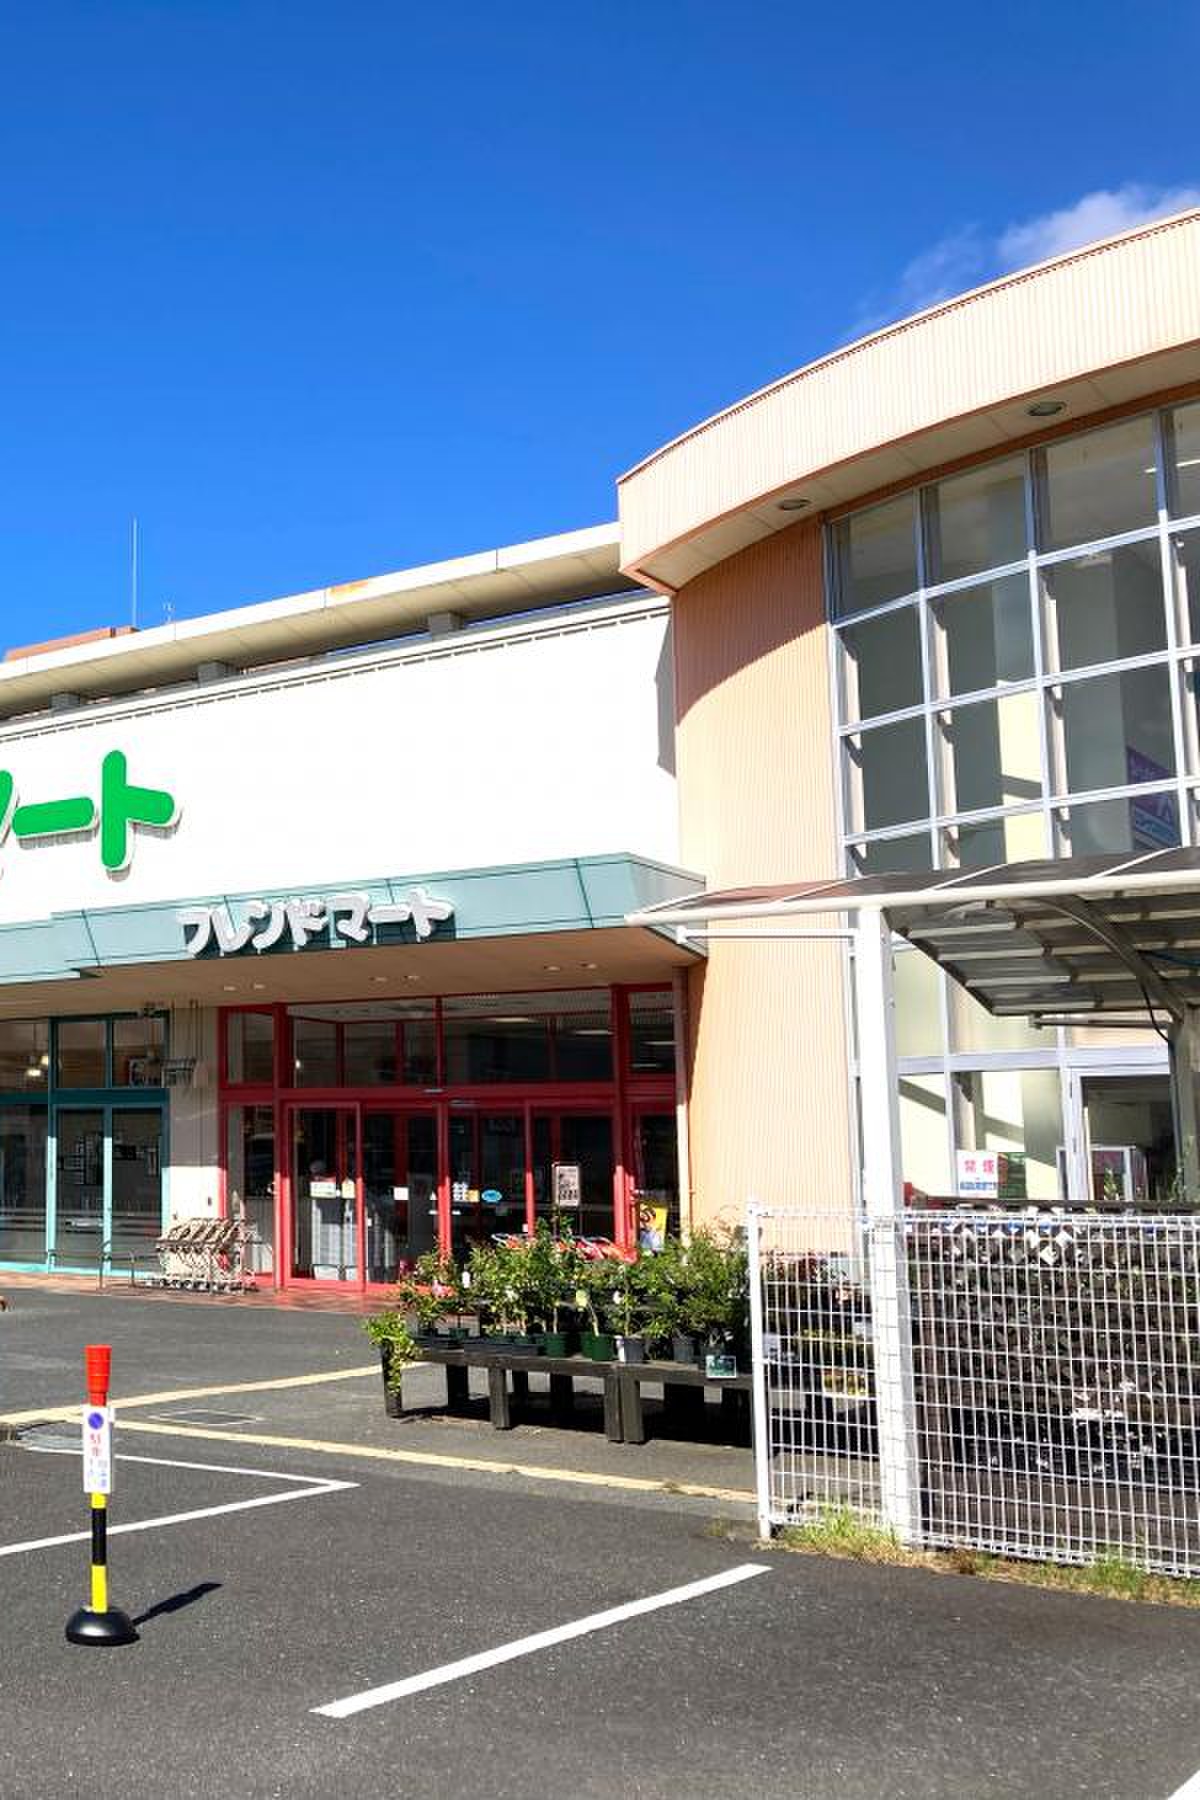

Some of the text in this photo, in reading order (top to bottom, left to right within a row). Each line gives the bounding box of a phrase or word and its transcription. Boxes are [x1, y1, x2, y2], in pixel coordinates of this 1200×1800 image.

[175, 887, 455, 958] フレンドマート
